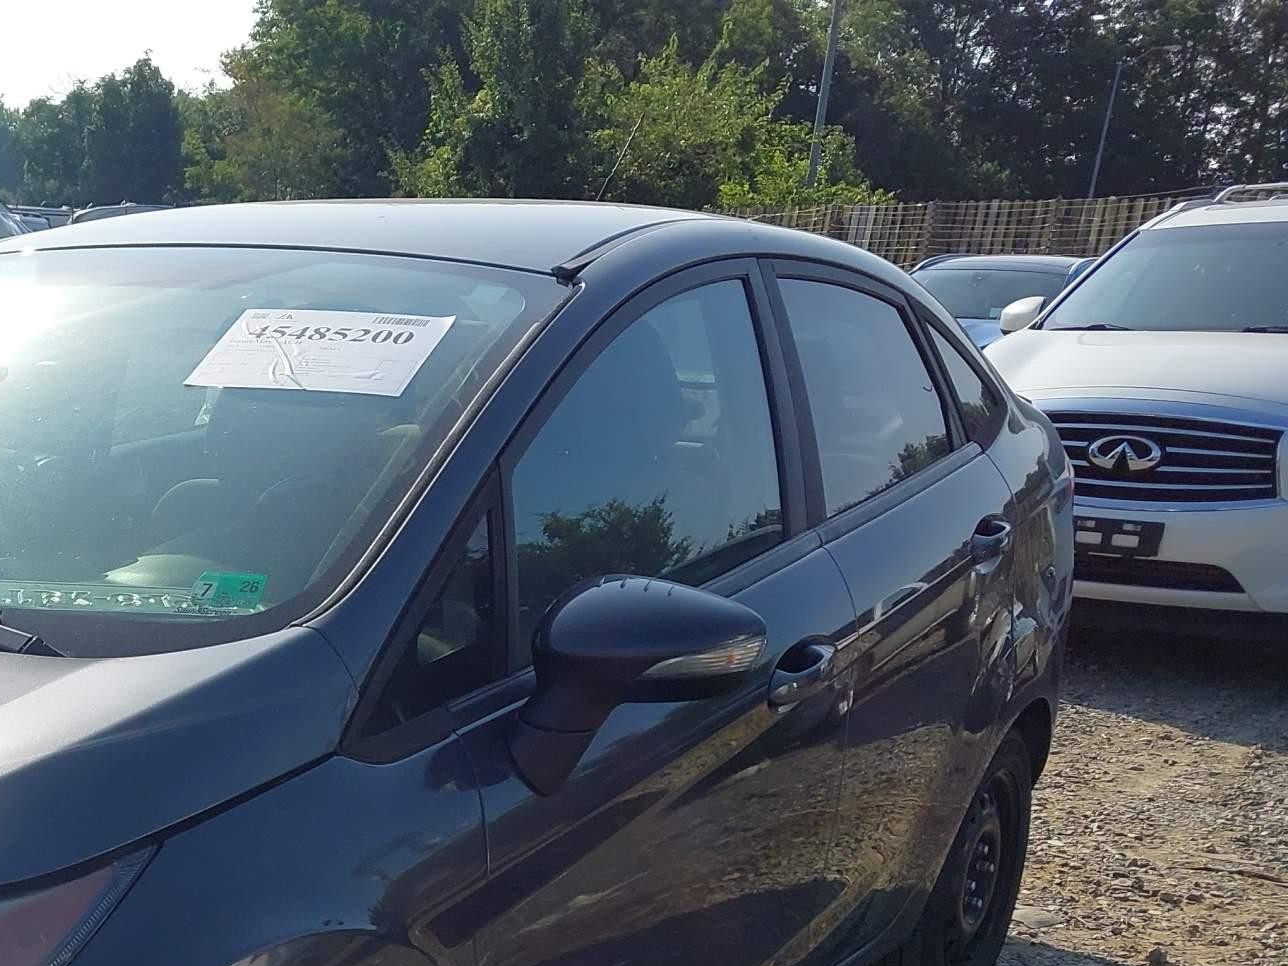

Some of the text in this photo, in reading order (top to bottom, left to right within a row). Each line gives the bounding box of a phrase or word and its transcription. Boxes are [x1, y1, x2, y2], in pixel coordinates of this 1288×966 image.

[248, 324, 415, 345] 45485200
[201, 583, 214, 598] 7
[239, 581, 261, 594] 26
